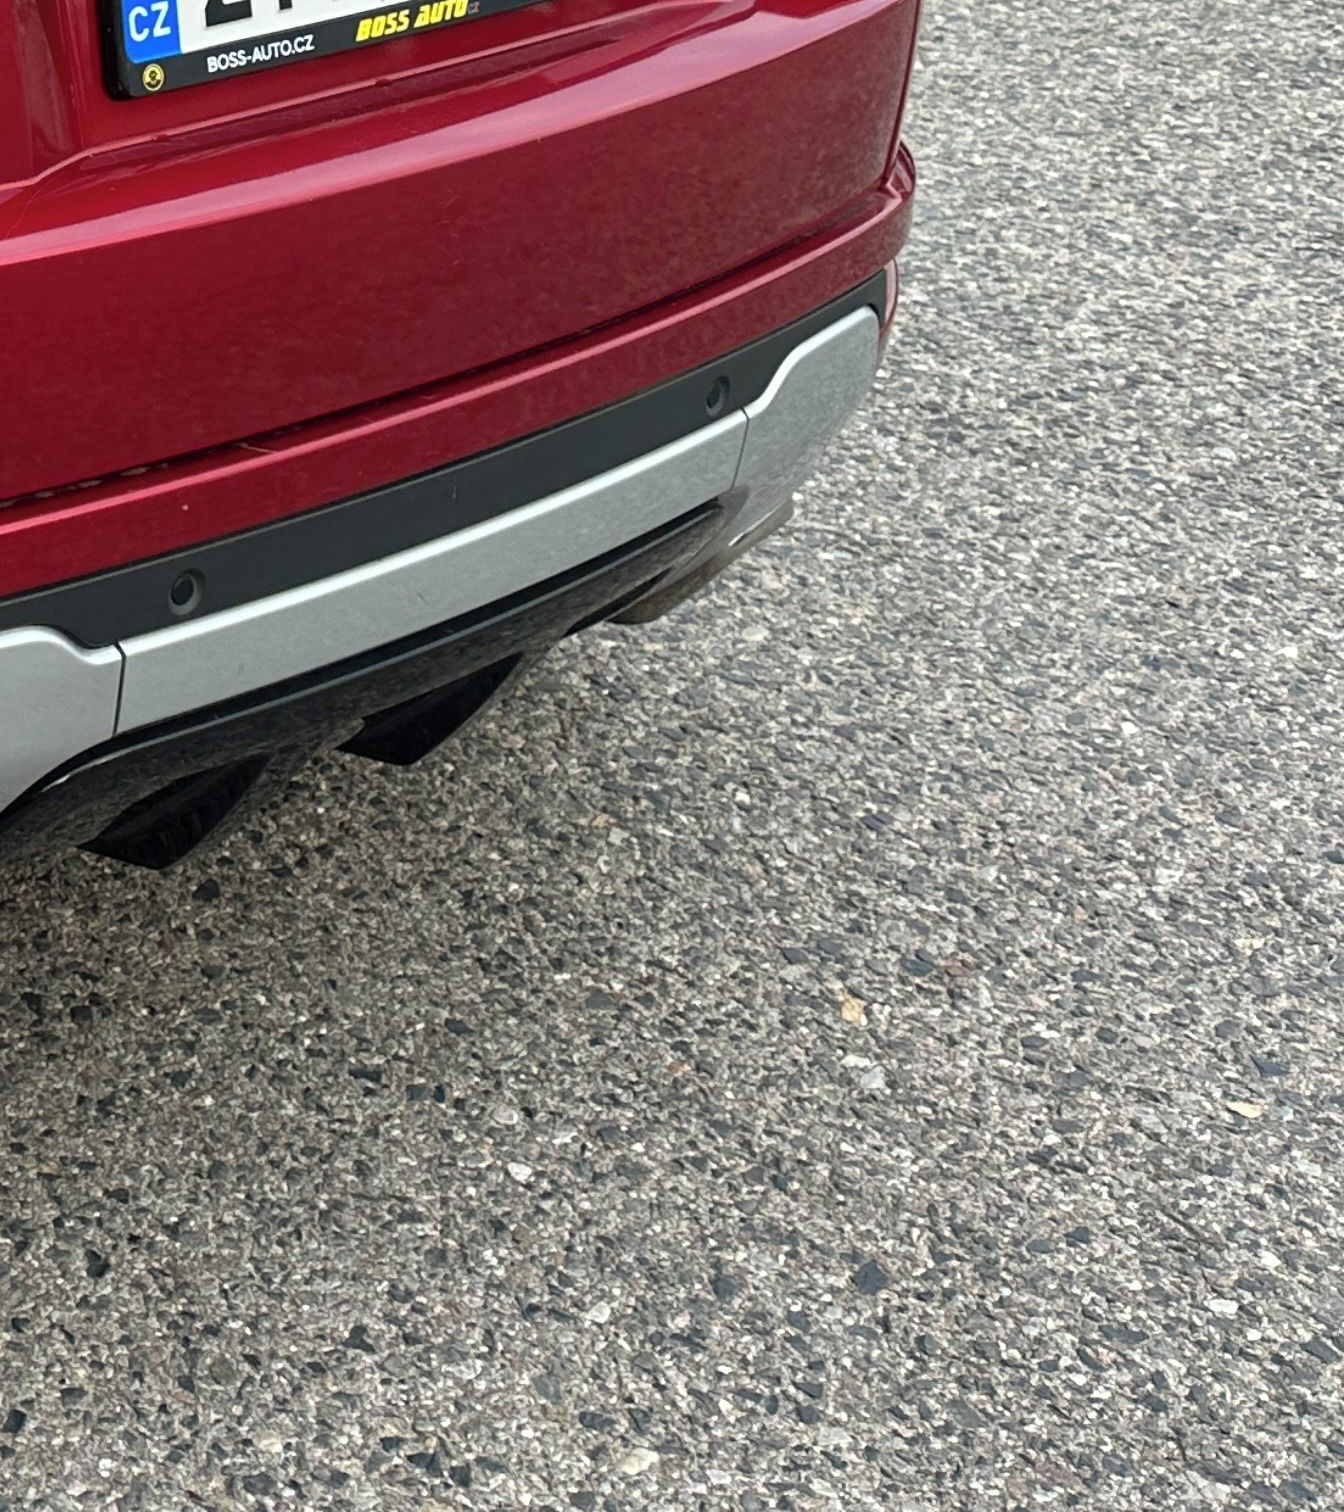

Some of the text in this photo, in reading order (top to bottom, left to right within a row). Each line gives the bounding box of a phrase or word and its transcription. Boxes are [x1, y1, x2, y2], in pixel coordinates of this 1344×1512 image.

[128, 0, 171, 42] CZ
[355, 9, 410, 42] BOSS
[207, 34, 315, 73] BOSS-AUTO.CZ
